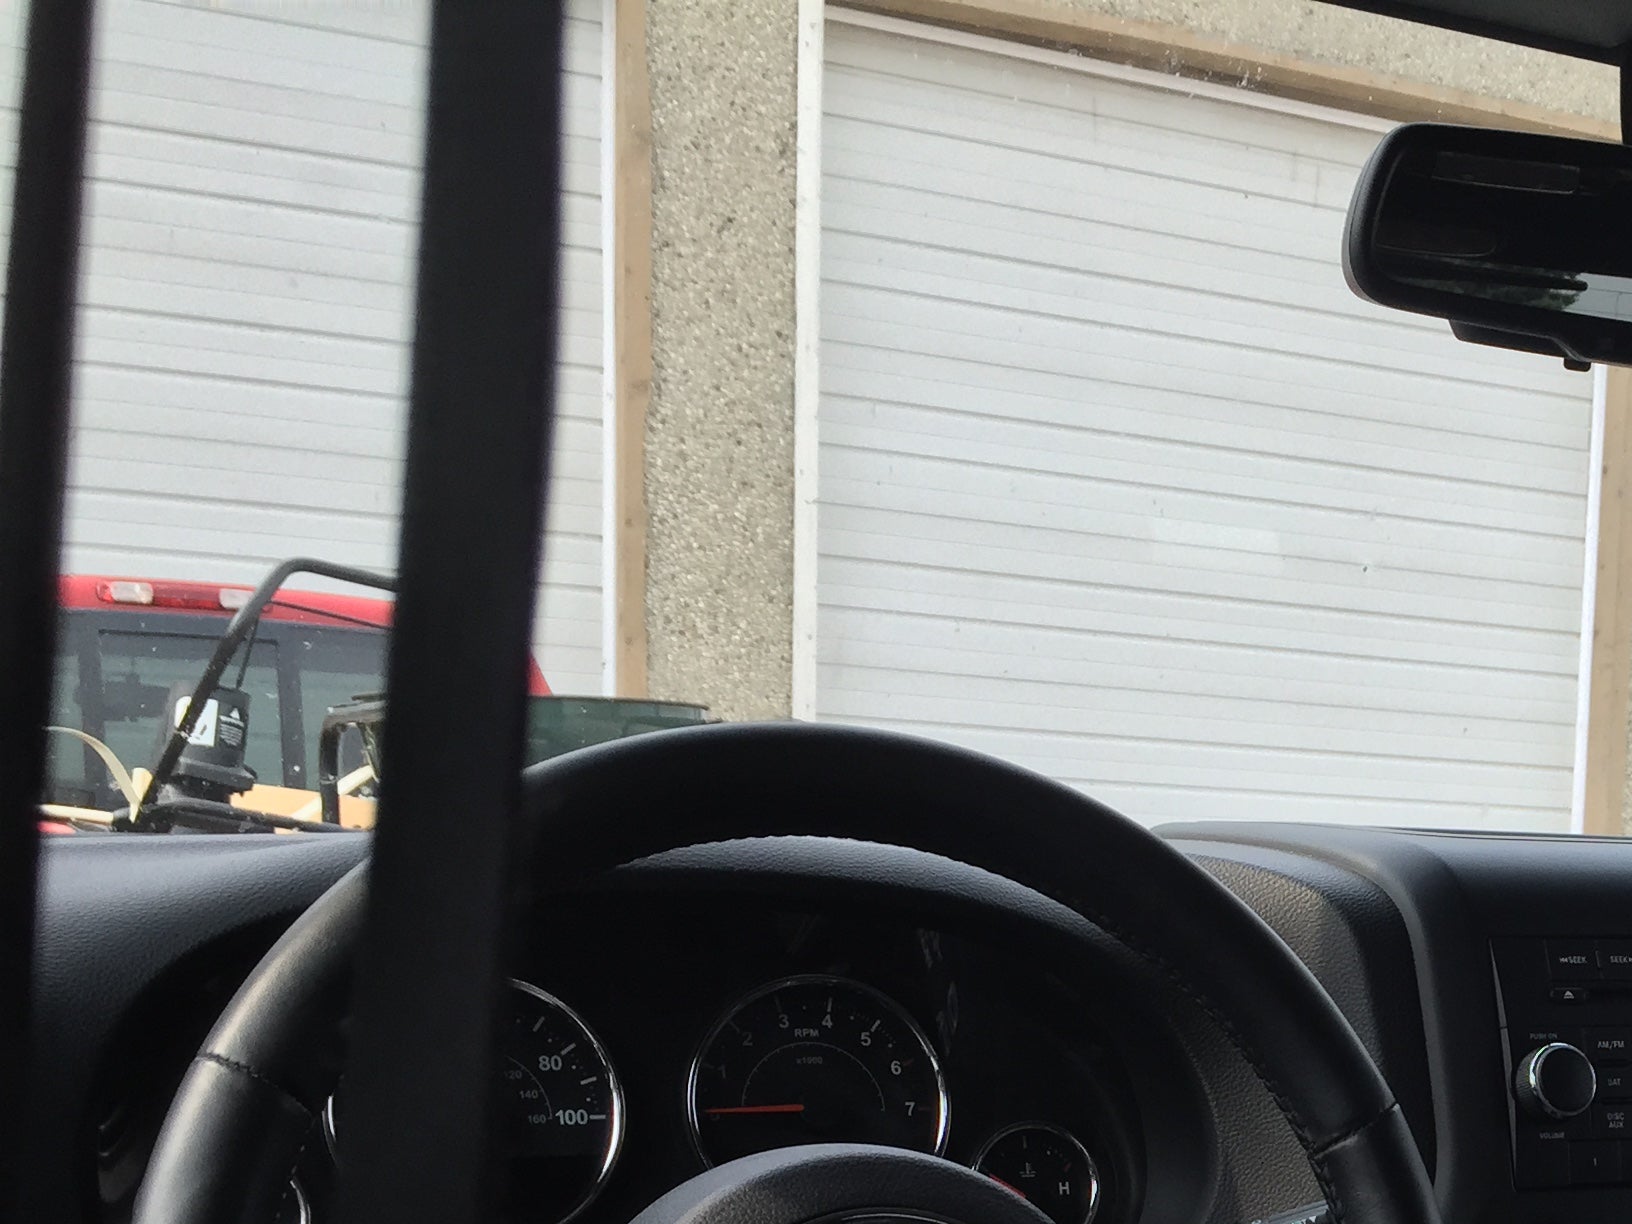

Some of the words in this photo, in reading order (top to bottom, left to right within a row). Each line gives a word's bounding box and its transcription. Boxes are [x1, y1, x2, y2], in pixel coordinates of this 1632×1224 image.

[778, 1014, 790, 1029] 3
[821, 1014, 833, 1029] 4
[741, 1032, 753, 1047] 2
[793, 1028, 820, 1039] RPM
[859, 1031, 872, 1047] 5
[1597, 1040, 1625, 1050] AM/FM
[538, 1054, 562, 1071] 80
[890, 1059, 902, 1075] 6
[520, 1089, 538, 1100] 140
[904, 1101, 916, 1117] 7
[1606, 1112, 1625, 1121] DISC
[527, 1113, 547, 1125] 160
[554, 1108, 588, 1126] 100
[1608, 1121, 1625, 1129] AUX
[1058, 1181, 1070, 1196] H
